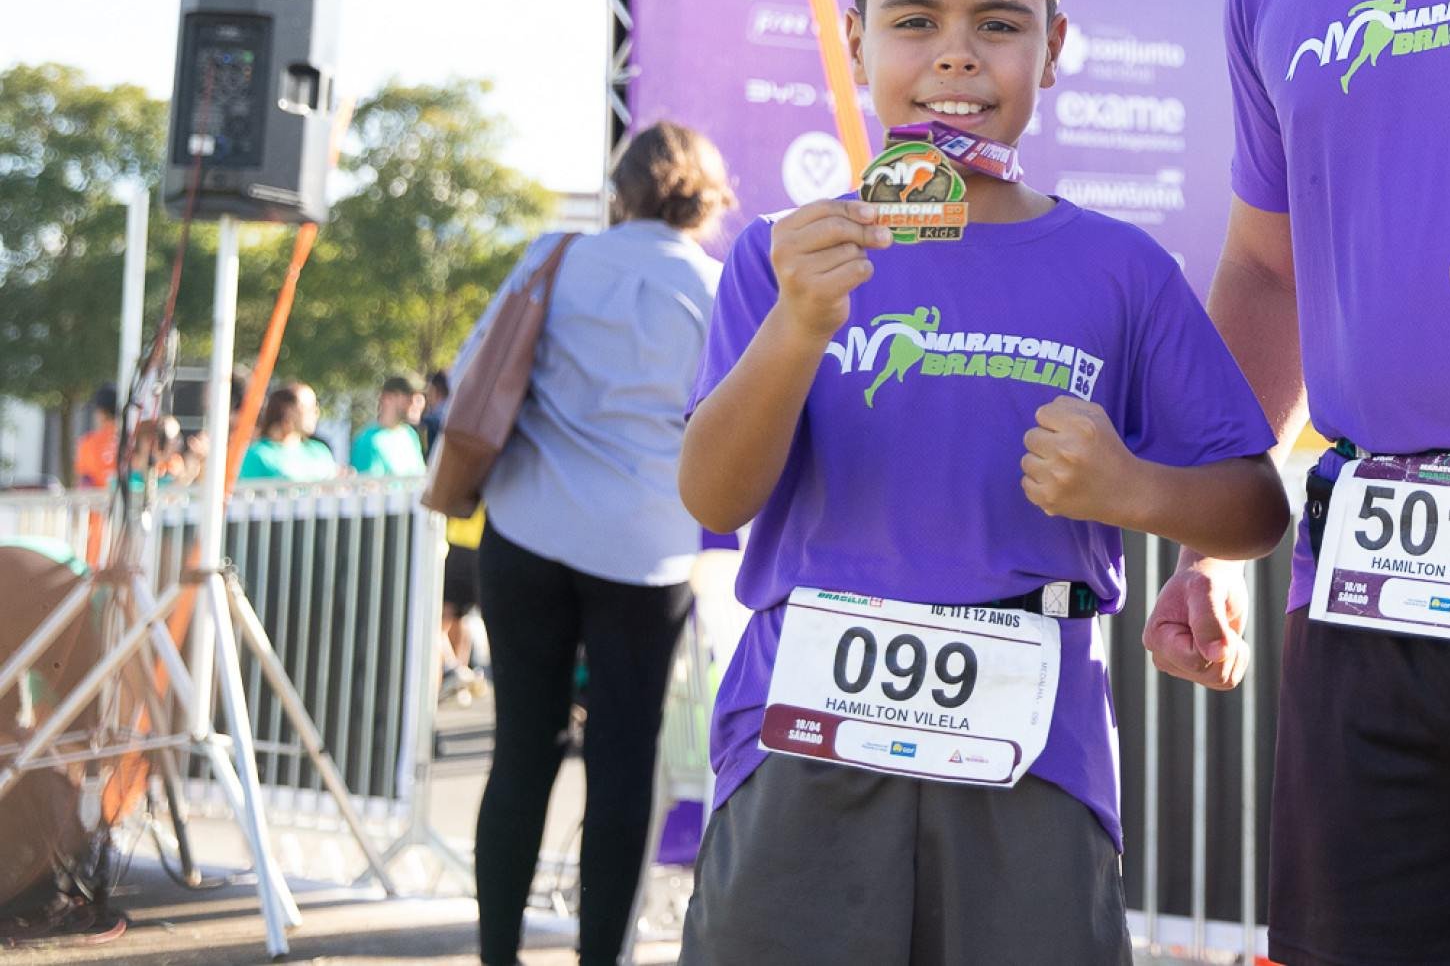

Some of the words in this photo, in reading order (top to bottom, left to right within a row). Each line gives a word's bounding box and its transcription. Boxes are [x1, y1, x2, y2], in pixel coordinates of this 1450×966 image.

[1055, 91, 1186, 134] exame
[879, 204, 942, 215] RATONA
[924, 332, 1075, 365] MARATONA
[1079, 357, 1096, 377] 20
[1075, 375, 1090, 396] 26
[1372, 556, 1447, 578] HAMILTON
[963, 607, 970, 620] E
[973, 608, 986, 622] 12
[988, 609, 1021, 628] ANOS
[833, 626, 978, 708] 099
[826, 697, 908, 722] HAMILTON
[914, 709, 970, 731] VILELA
